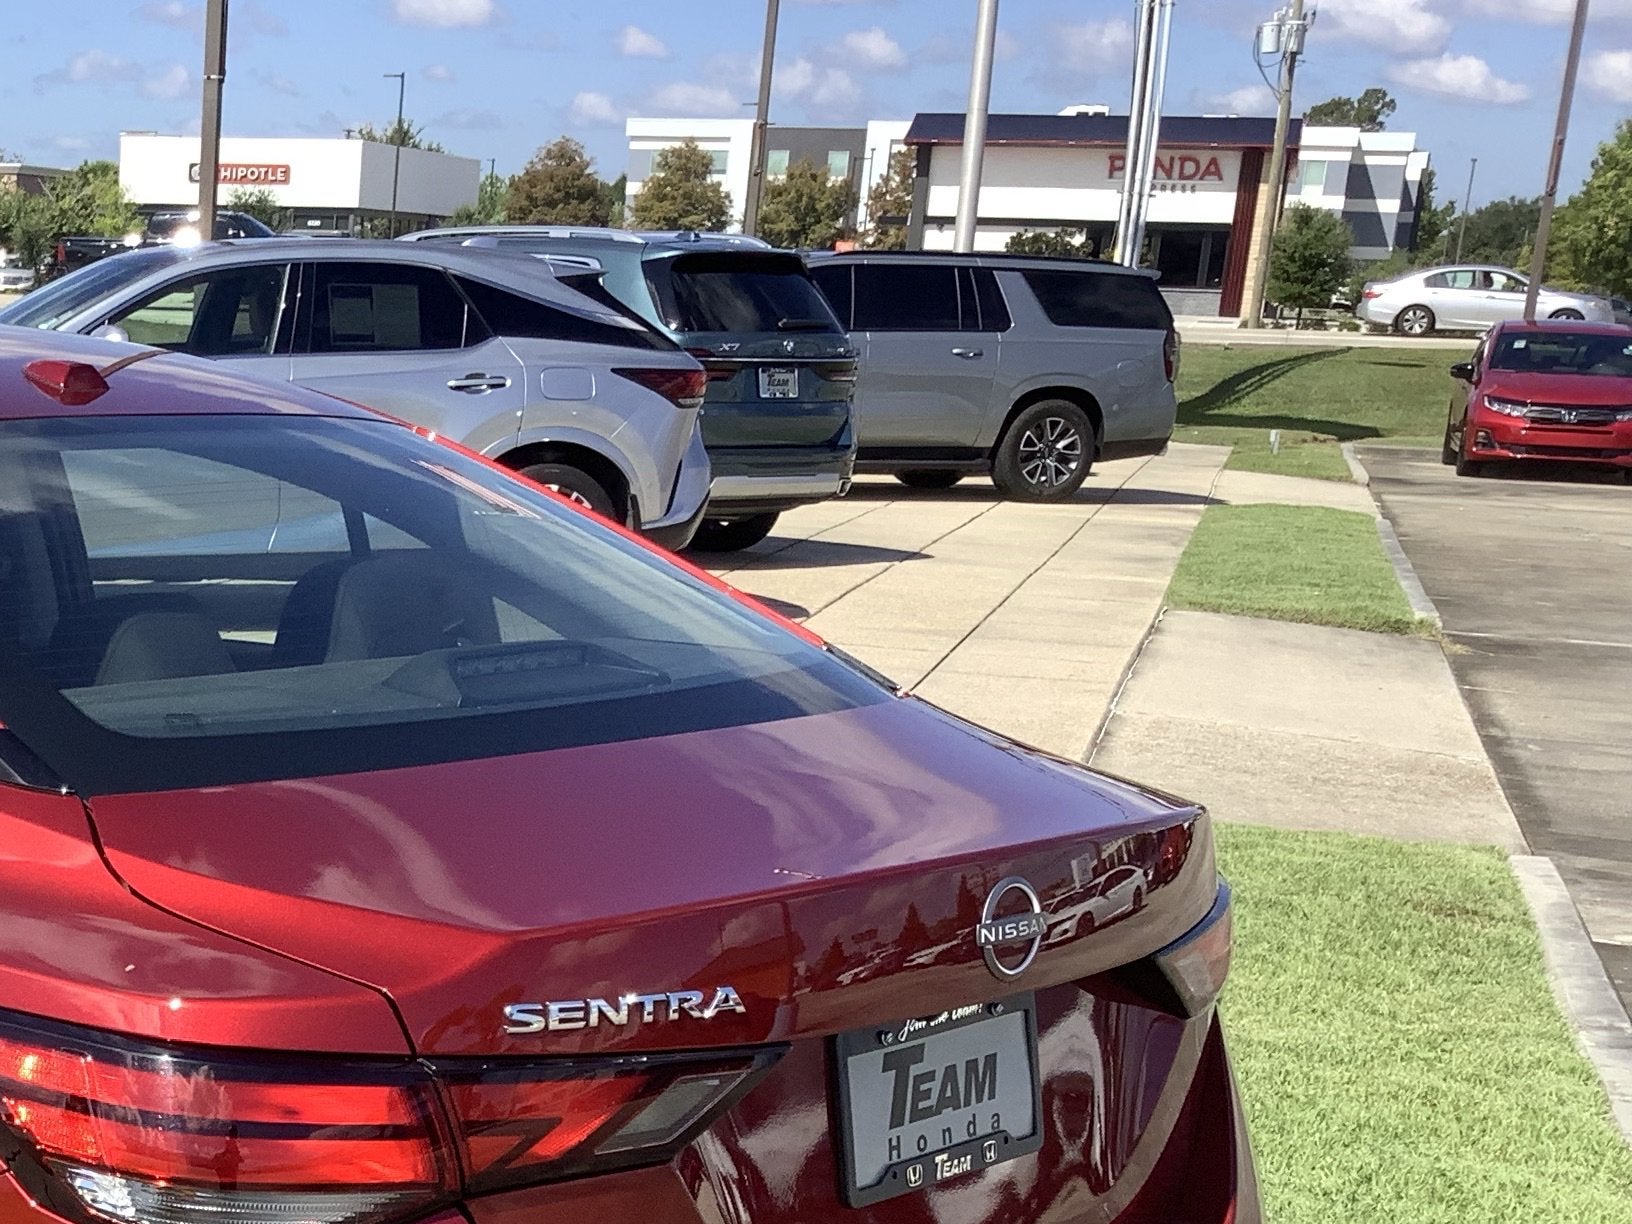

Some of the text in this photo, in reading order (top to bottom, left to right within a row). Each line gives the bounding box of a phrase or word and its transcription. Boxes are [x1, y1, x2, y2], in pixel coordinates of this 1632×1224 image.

[219, 167, 287, 181] HIPOTLE
[1108, 155, 1223, 181] PNDA
[980, 917, 1047, 943] NISSAN
[503, 986, 746, 1034] SENTRA
[881, 1042, 998, 1131] TEAM
[887, 1112, 1001, 1162] Honda
[934, 1153, 972, 1181] TEAM
